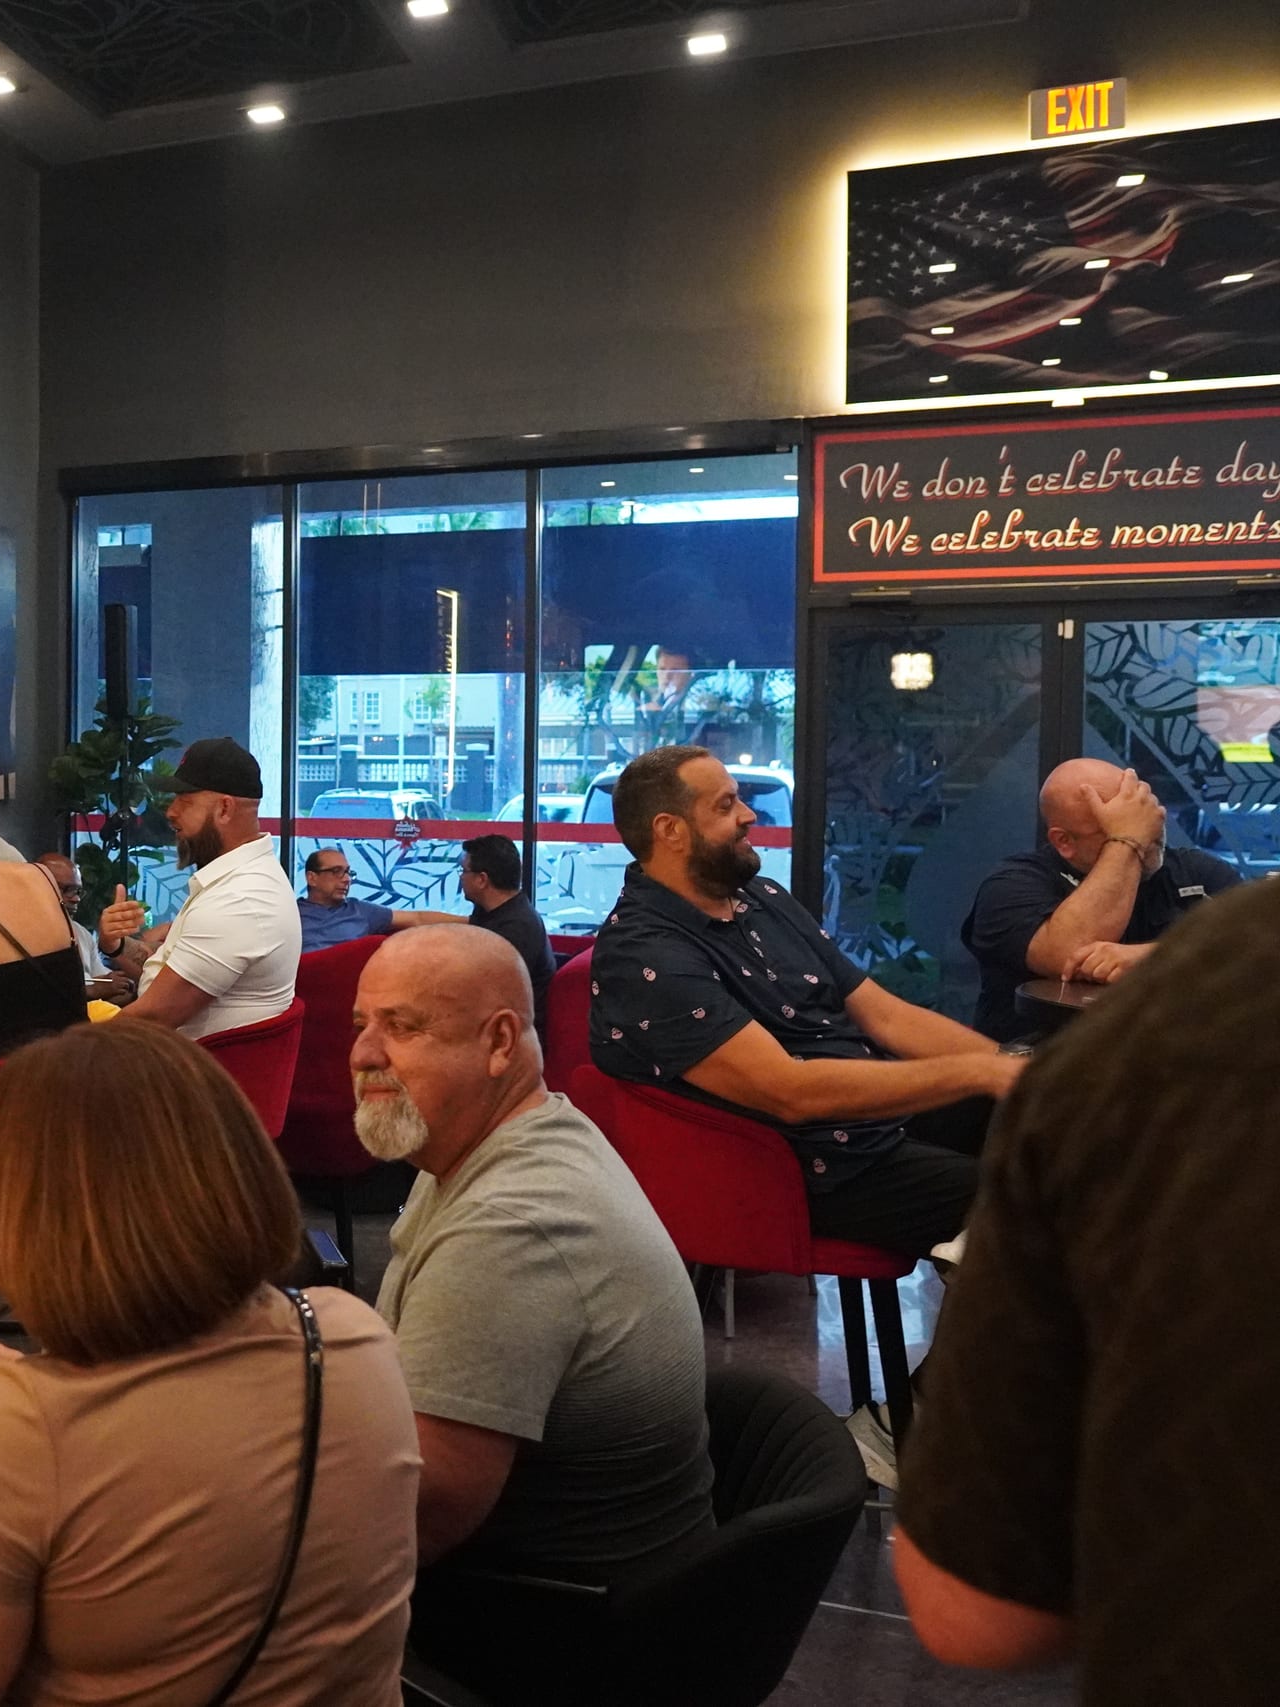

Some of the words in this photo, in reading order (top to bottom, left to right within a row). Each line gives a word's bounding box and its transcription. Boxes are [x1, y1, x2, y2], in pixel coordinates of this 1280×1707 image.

[1047, 81, 1114, 134] EXIT
[839, 461, 911, 502] We
[922, 445, 1016, 499] don't
[1025, 447, 1204, 495] celebrate
[848, 514, 922, 558] We
[930, 508, 1103, 555] celebrate
[1110, 510, 1280, 550] moments
